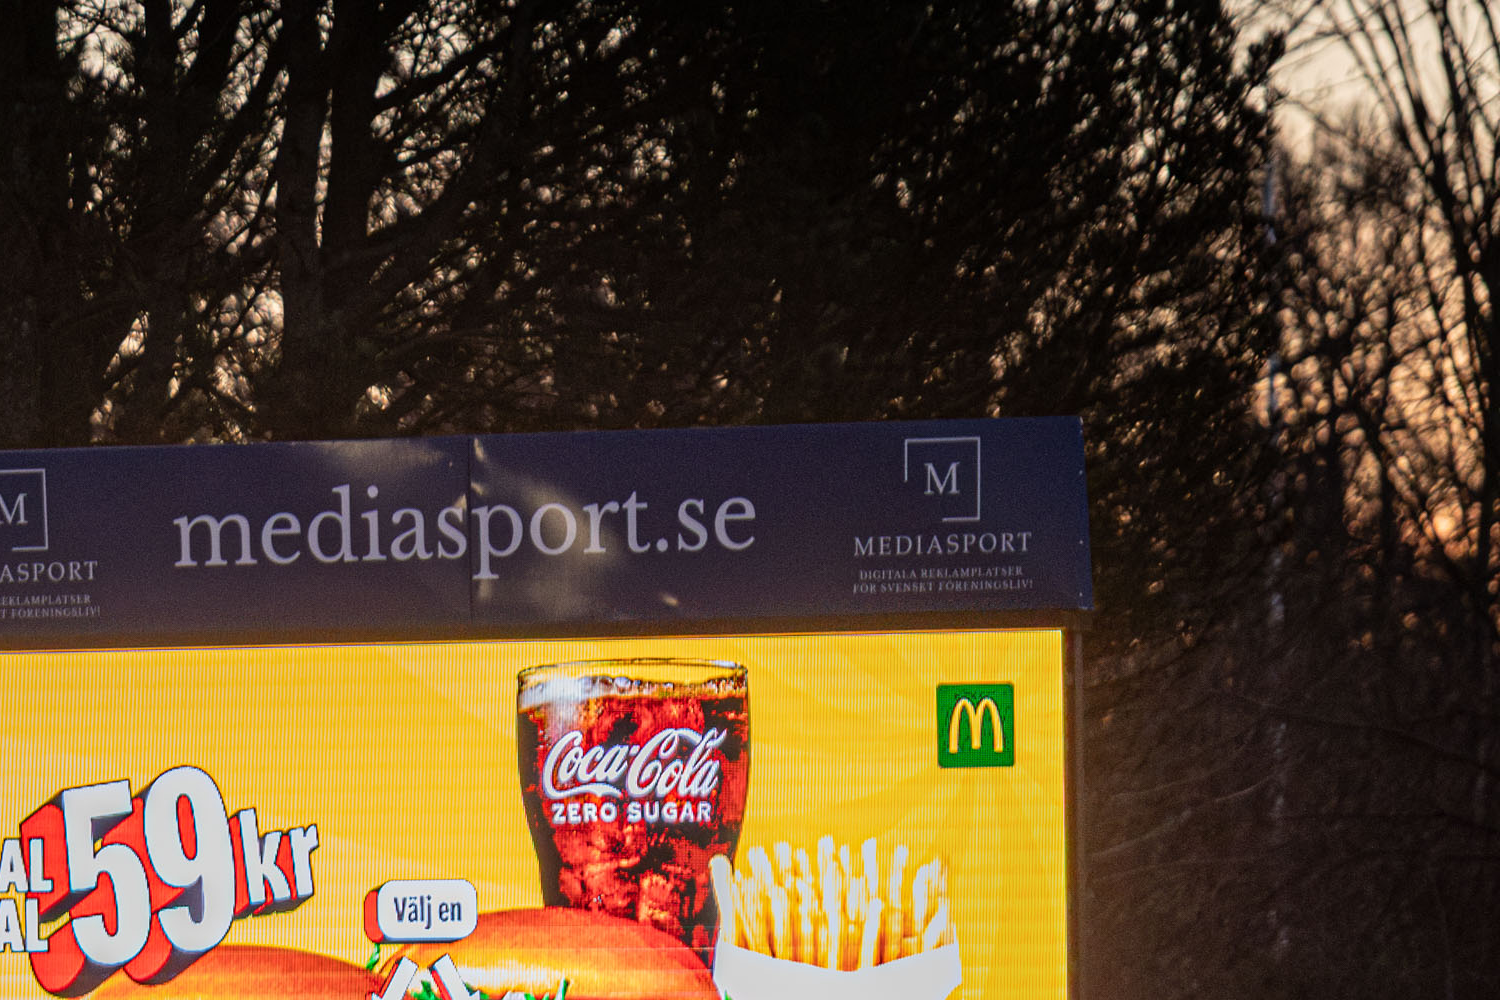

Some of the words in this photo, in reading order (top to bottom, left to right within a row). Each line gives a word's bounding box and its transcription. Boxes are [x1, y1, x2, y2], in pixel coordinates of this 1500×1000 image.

[924, 461, 961, 496] M
[173, 484, 757, 581] mediasport.se
[853, 531, 1033, 557] MEDIASPORT
[859, 568, 917, 581] DIGITALA
[920, 565, 1023, 578] REKLAMPLATSER
[880, 580, 935, 593] SVENSKT
[542, 727, 727, 799] Coca-Cola
[551, 801, 618, 825] ZERO
[626, 800, 713, 824] SUGAR
[393, 895, 432, 930] Välj
[438, 902, 462, 922] en
